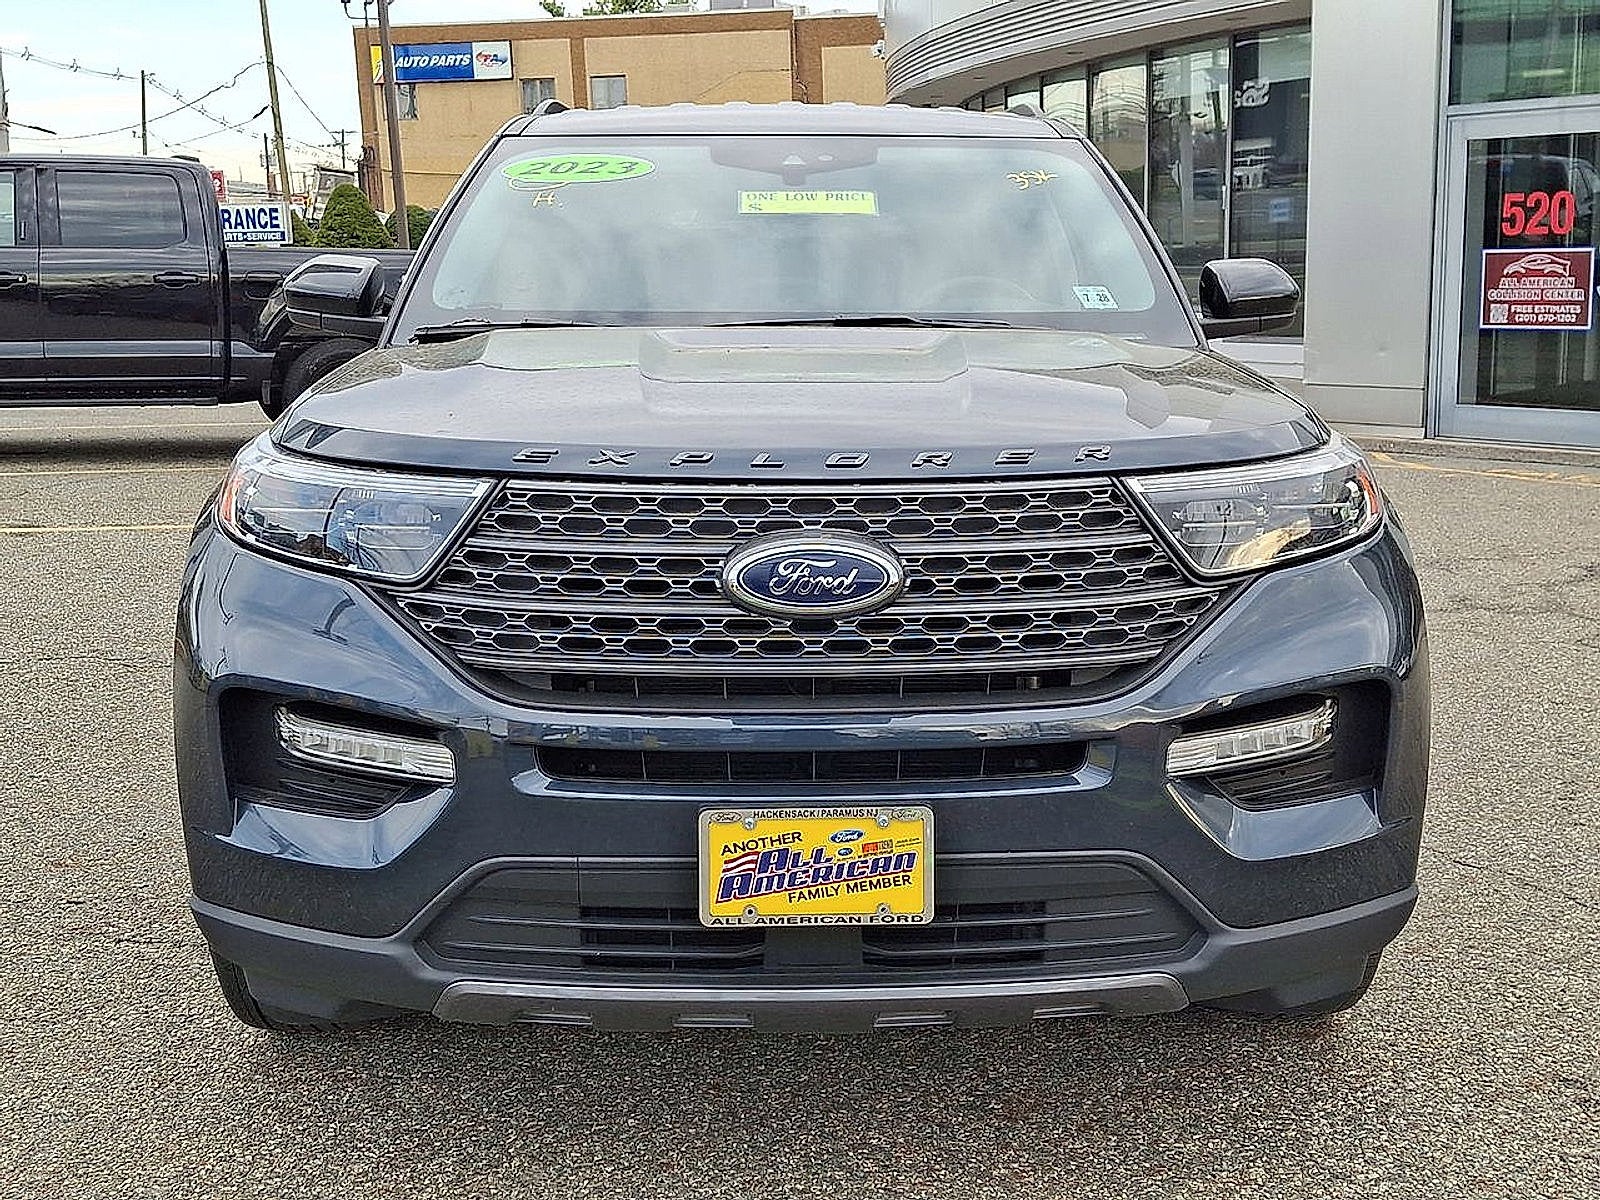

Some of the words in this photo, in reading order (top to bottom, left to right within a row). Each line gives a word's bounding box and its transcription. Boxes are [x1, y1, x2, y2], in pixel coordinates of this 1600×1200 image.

[395, 56, 428, 68] AUTO
[430, 54, 472, 66] PARTS
[519, 161, 639, 175] 2023
[746, 193, 778, 201] ONE
[785, 193, 818, 201] LOW
[825, 192, 871, 201] PRICE
[1501, 190, 1576, 236] 520
[1499, 277, 1520, 288] ALL
[1520, 277, 1575, 288] AMERICAN
[1488, 289, 1541, 301] COLLISION
[1542, 289, 1585, 301] CENTER
[1511, 304, 1533, 313] FREE
[1534, 304, 1582, 313] ESTIMATES
[512, 444, 1113, 469] EXPLORER
[768, 558, 859, 596] Ford
[720, 831, 803, 856] ANOTHER
[717, 851, 918, 902] AMERICAN
[787, 884, 841, 904] FAMILY
[845, 874, 913, 896] MEMBER
[710, 916, 745, 926] ALL
[755, 916, 862, 925] AMERICAN
[869, 914, 924, 924] FORD
